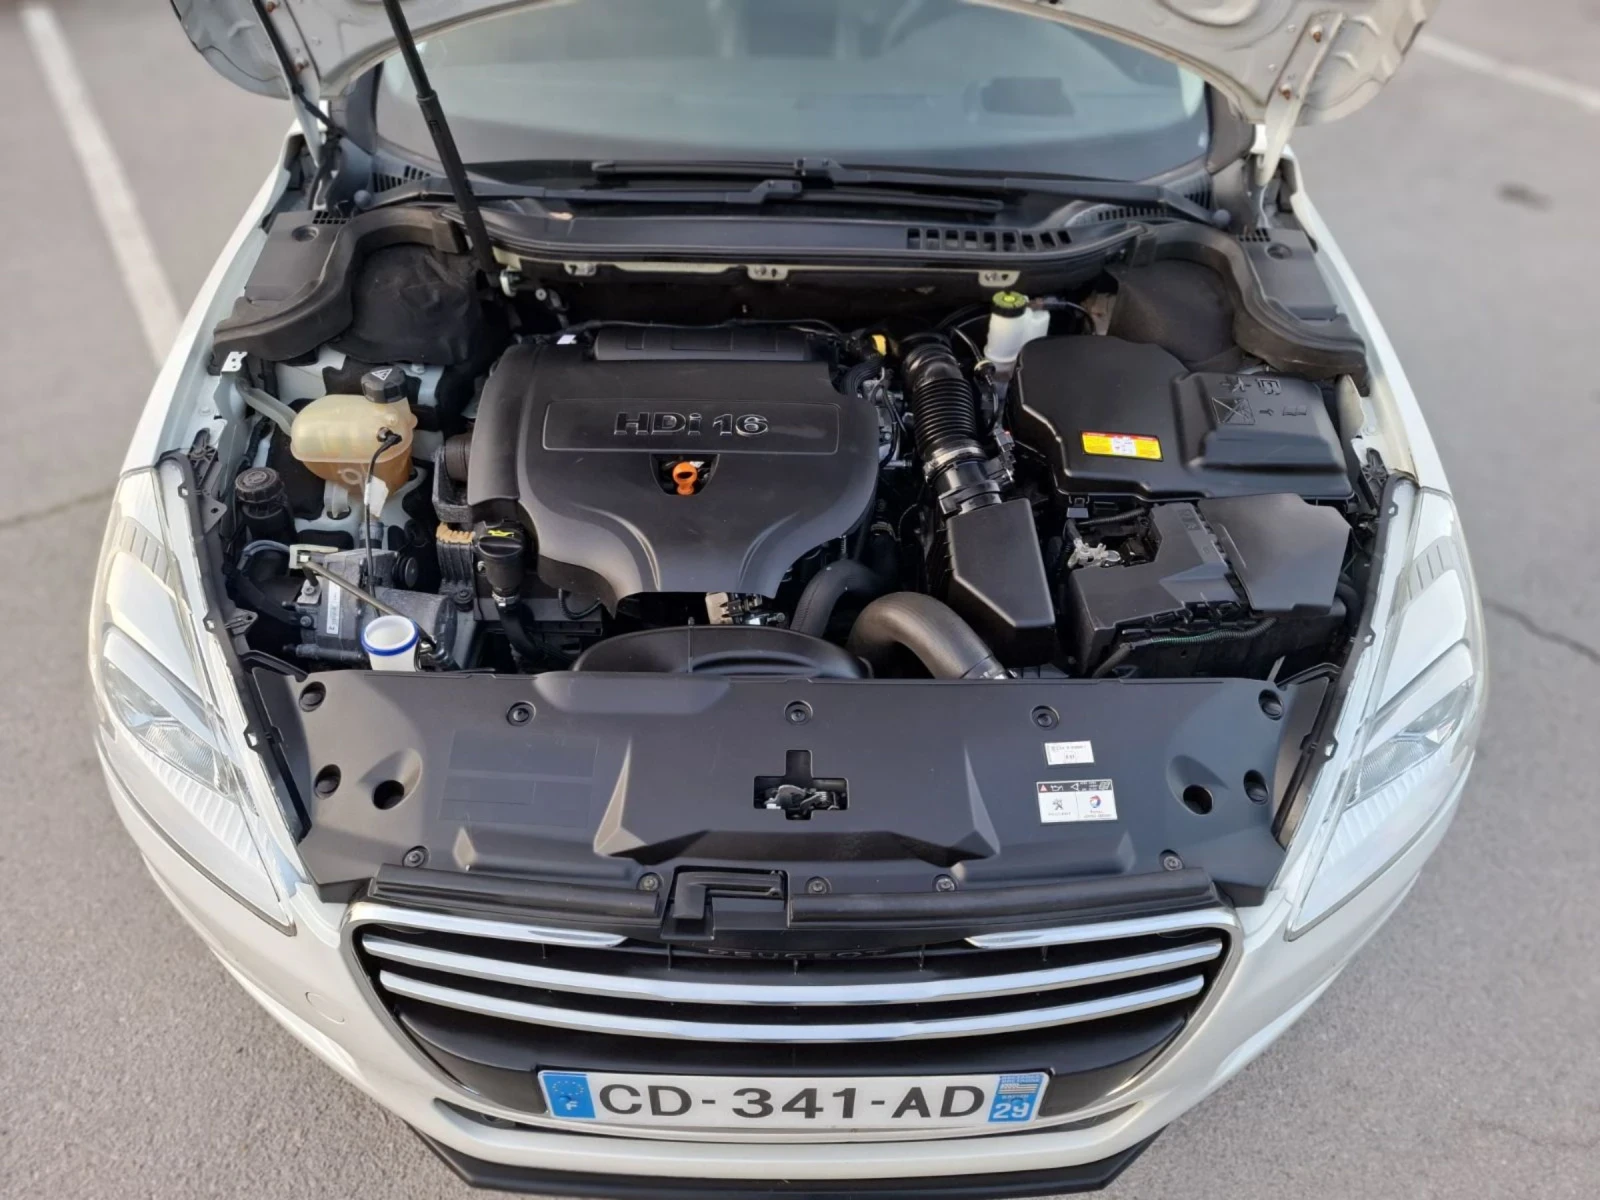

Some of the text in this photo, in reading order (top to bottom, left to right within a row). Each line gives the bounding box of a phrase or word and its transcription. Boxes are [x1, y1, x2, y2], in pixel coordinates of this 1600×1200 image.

[613, 411, 769, 437] HDi 16
[599, 1083, 986, 1119] CD-341-AD
[992, 1102, 1030, 1119] 29
